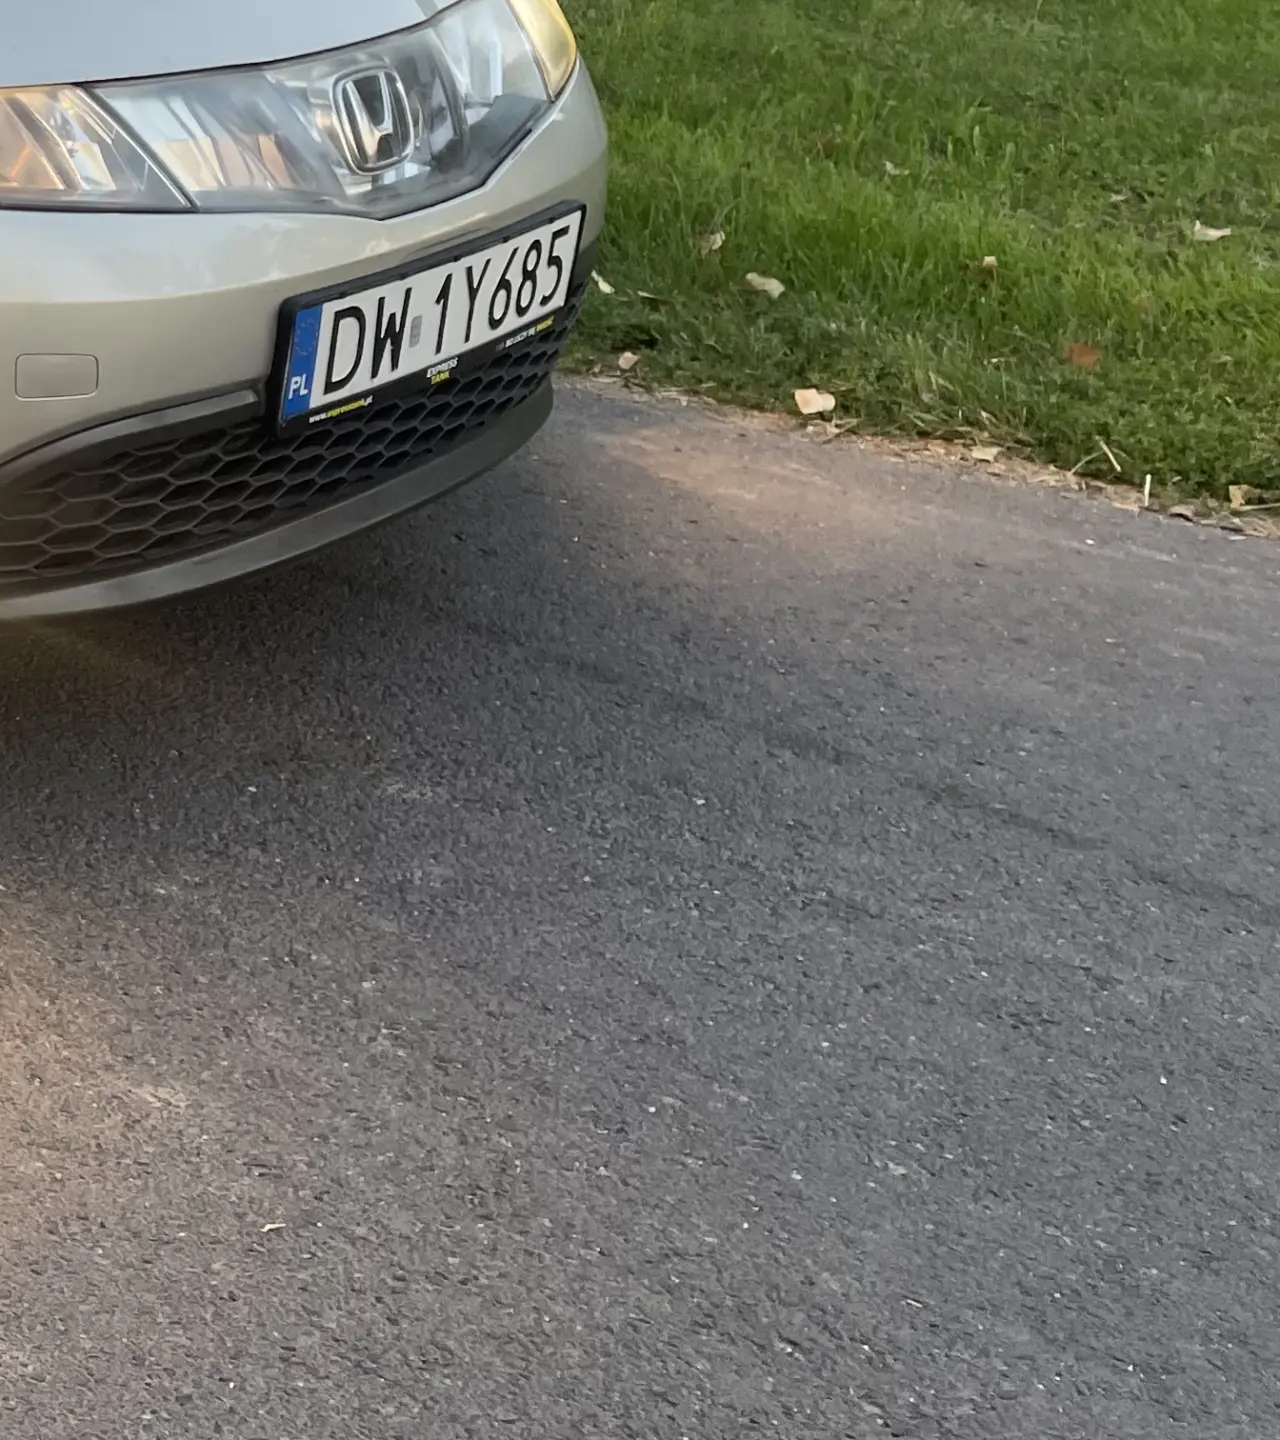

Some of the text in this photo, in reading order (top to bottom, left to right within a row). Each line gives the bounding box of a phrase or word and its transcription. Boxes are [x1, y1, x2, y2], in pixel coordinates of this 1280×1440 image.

[324, 225, 570, 395] DW 1Y685
[288, 373, 309, 400] PL
